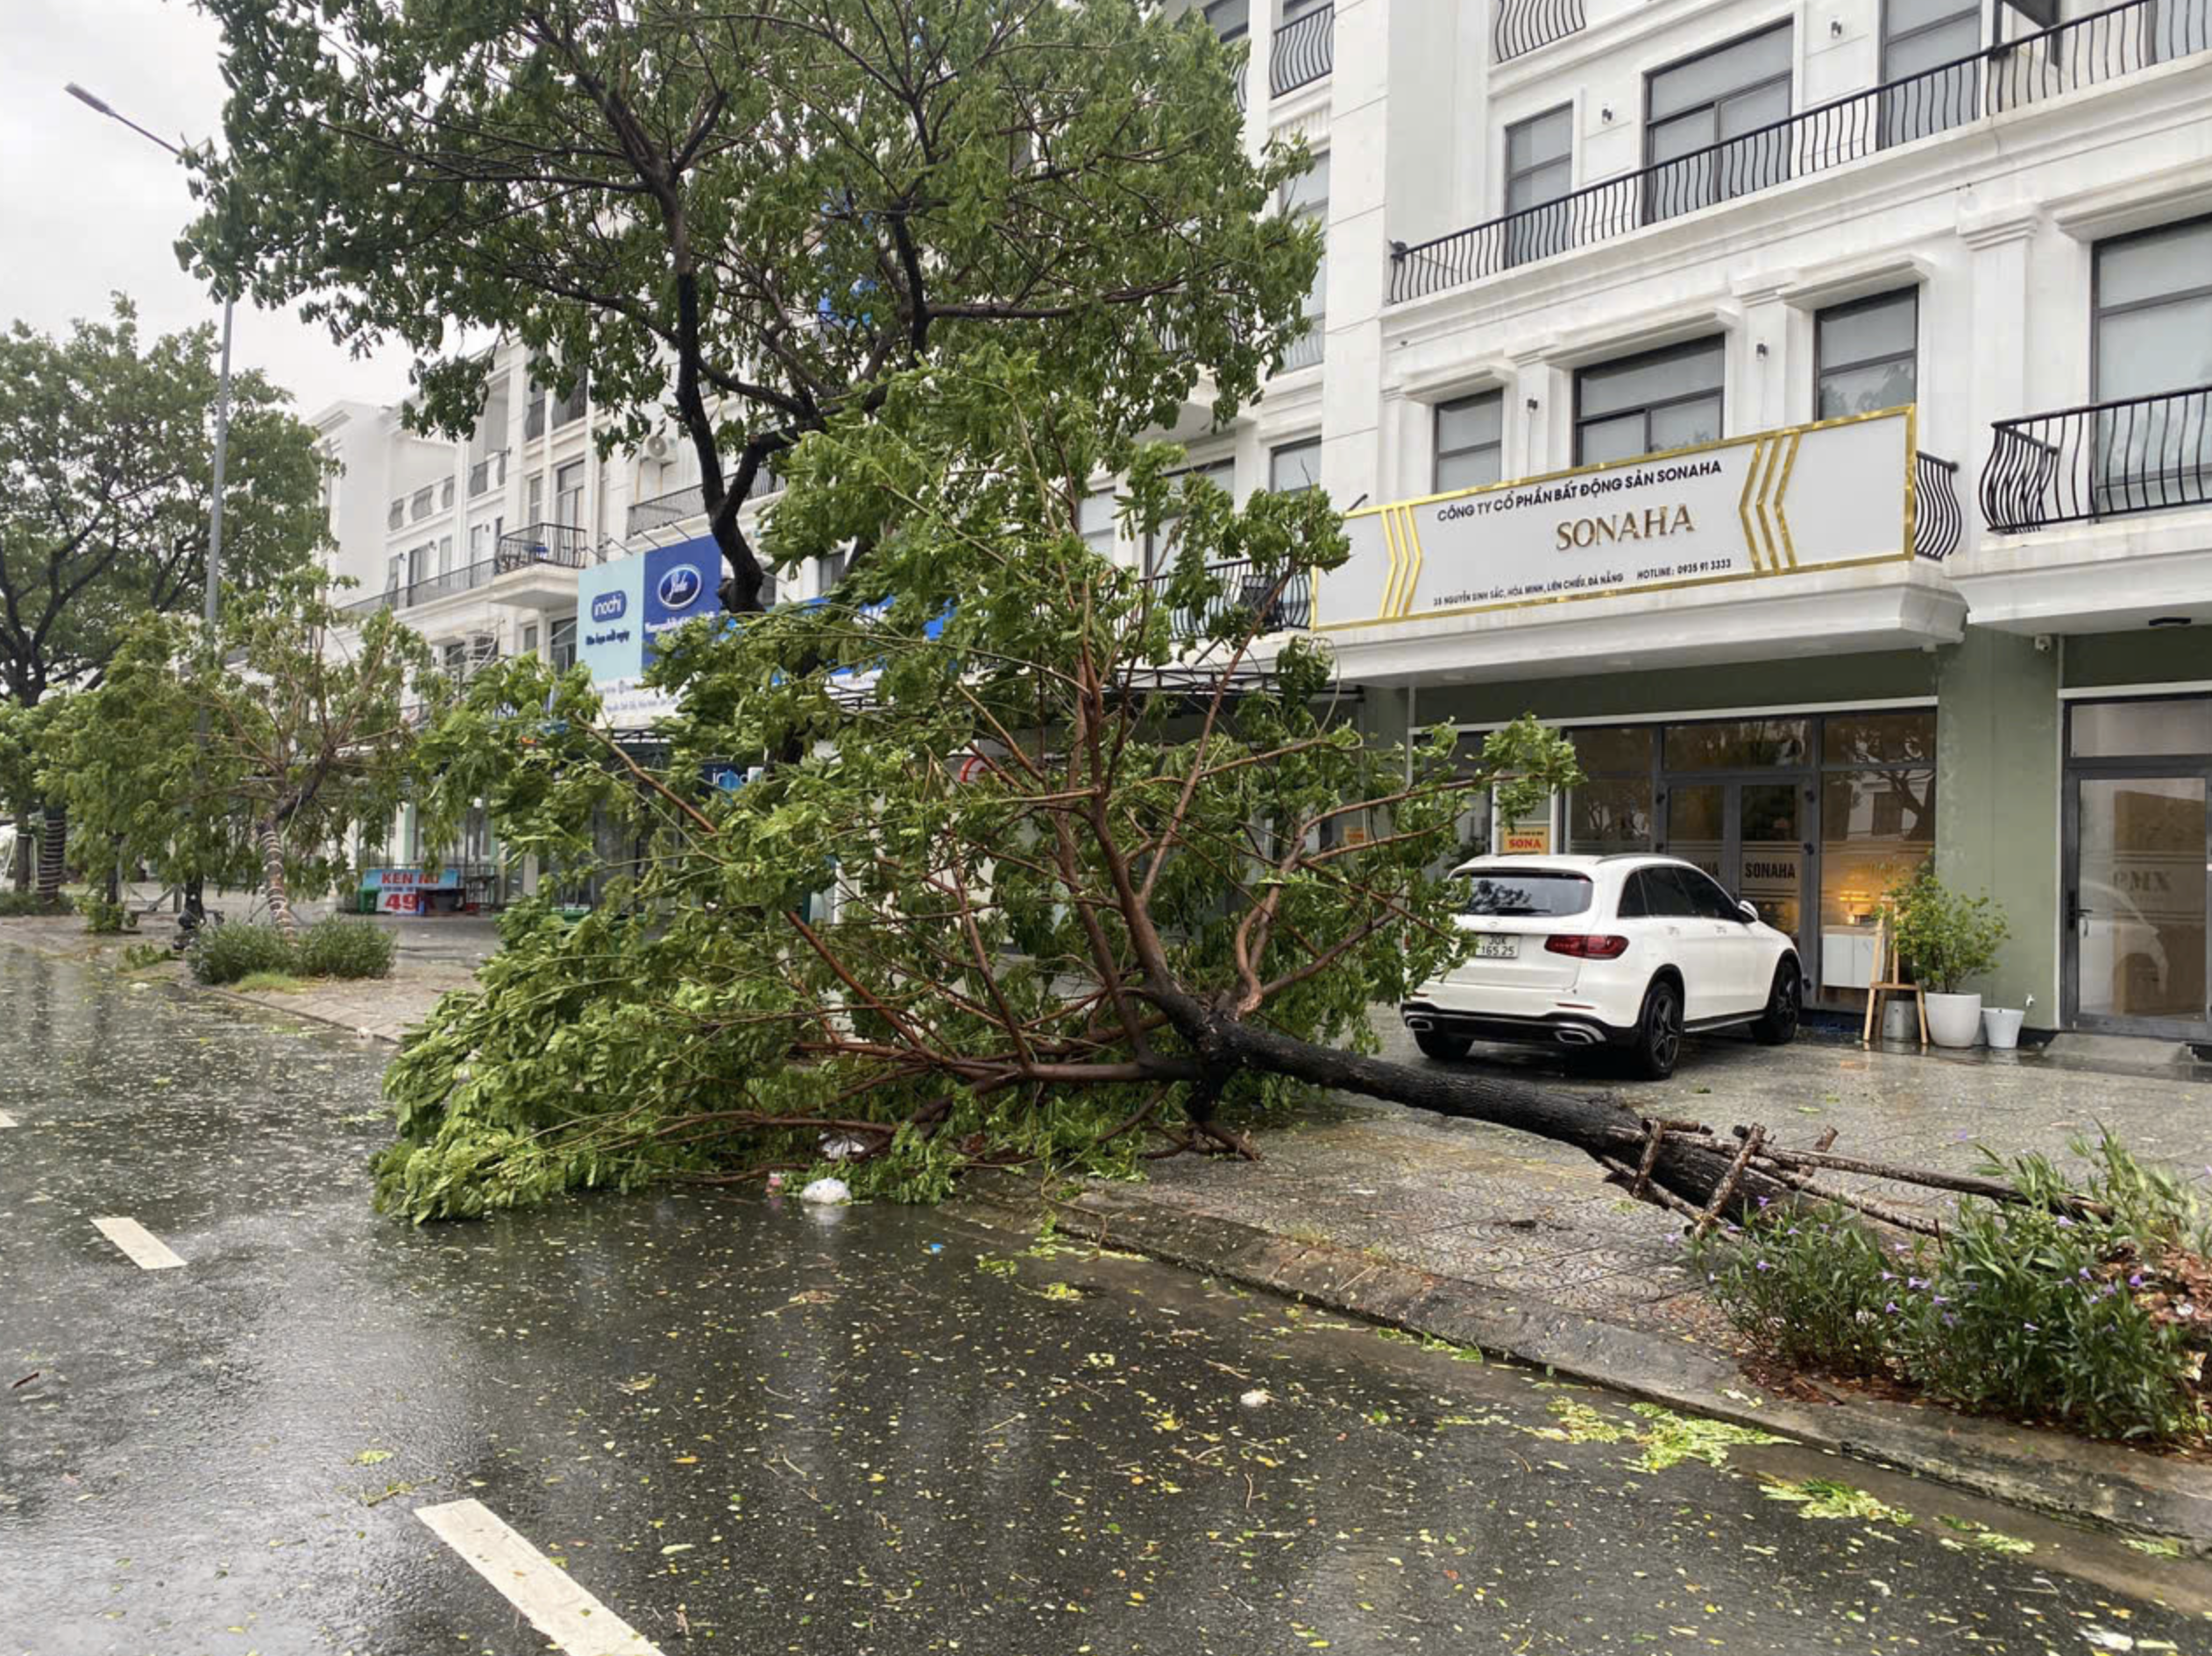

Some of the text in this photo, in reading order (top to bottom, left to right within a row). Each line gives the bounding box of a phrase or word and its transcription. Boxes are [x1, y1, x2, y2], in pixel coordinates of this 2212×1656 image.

[1437, 504, 1475, 521] CÔNG
[1478, 501, 1492, 514] TY
[1493, 491, 1514, 512] CỔ
[1554, 480, 1577, 501] BẤT
[1580, 478, 1622, 498] ĐỘNG
[1626, 470, 1654, 489] SẢN
[1657, 461, 1721, 483] SONAHA
[1556, 503, 1696, 551] SONAHA
[1637, 567, 1674, 579] HOTLINE:
[1677, 563, 1697, 574] 0935
[1699, 561, 1708, 570] 91
[1711, 558, 1732, 570] 3333
[1509, 839, 1542, 849] SONA
[381, 872, 413, 884] KEN
[1745, 862, 1796, 879] SONAHA
